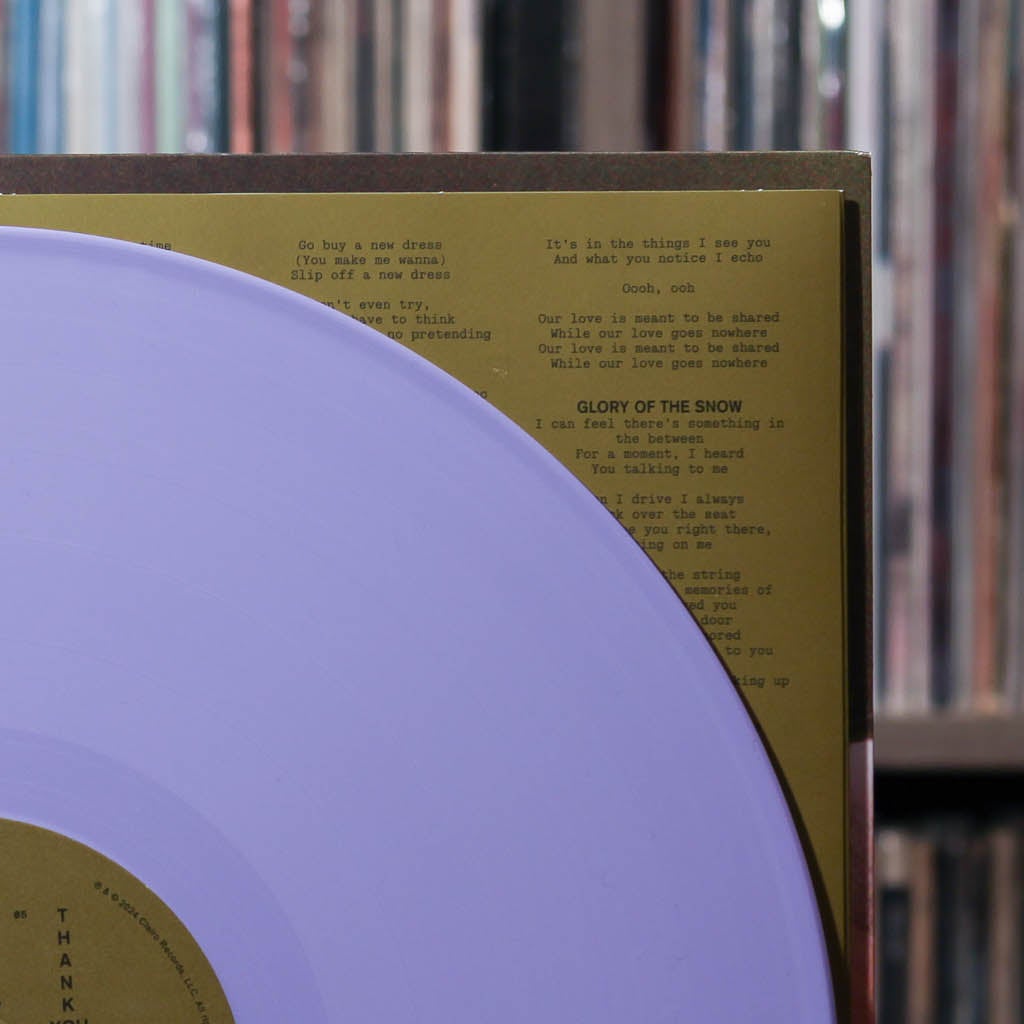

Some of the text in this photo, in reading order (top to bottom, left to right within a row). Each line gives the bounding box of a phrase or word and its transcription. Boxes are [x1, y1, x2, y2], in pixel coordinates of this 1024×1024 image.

[298, 239, 443, 253] Go buy a new dress
[546, 238, 771, 252] It's in the things I see you
[622, 282, 695, 295] Oooh, ooh
[550, 327, 768, 341] While our love goes nowhere
[577, 400, 742, 414] GLORY OF THE SNOW
[616, 432, 704, 443] the between
[592, 463, 728, 477] You talking to me
[632, 508, 737, 519] over the seat
[117, 897, 140, 919] 2024
[55, 907, 75, 1013] THANK
